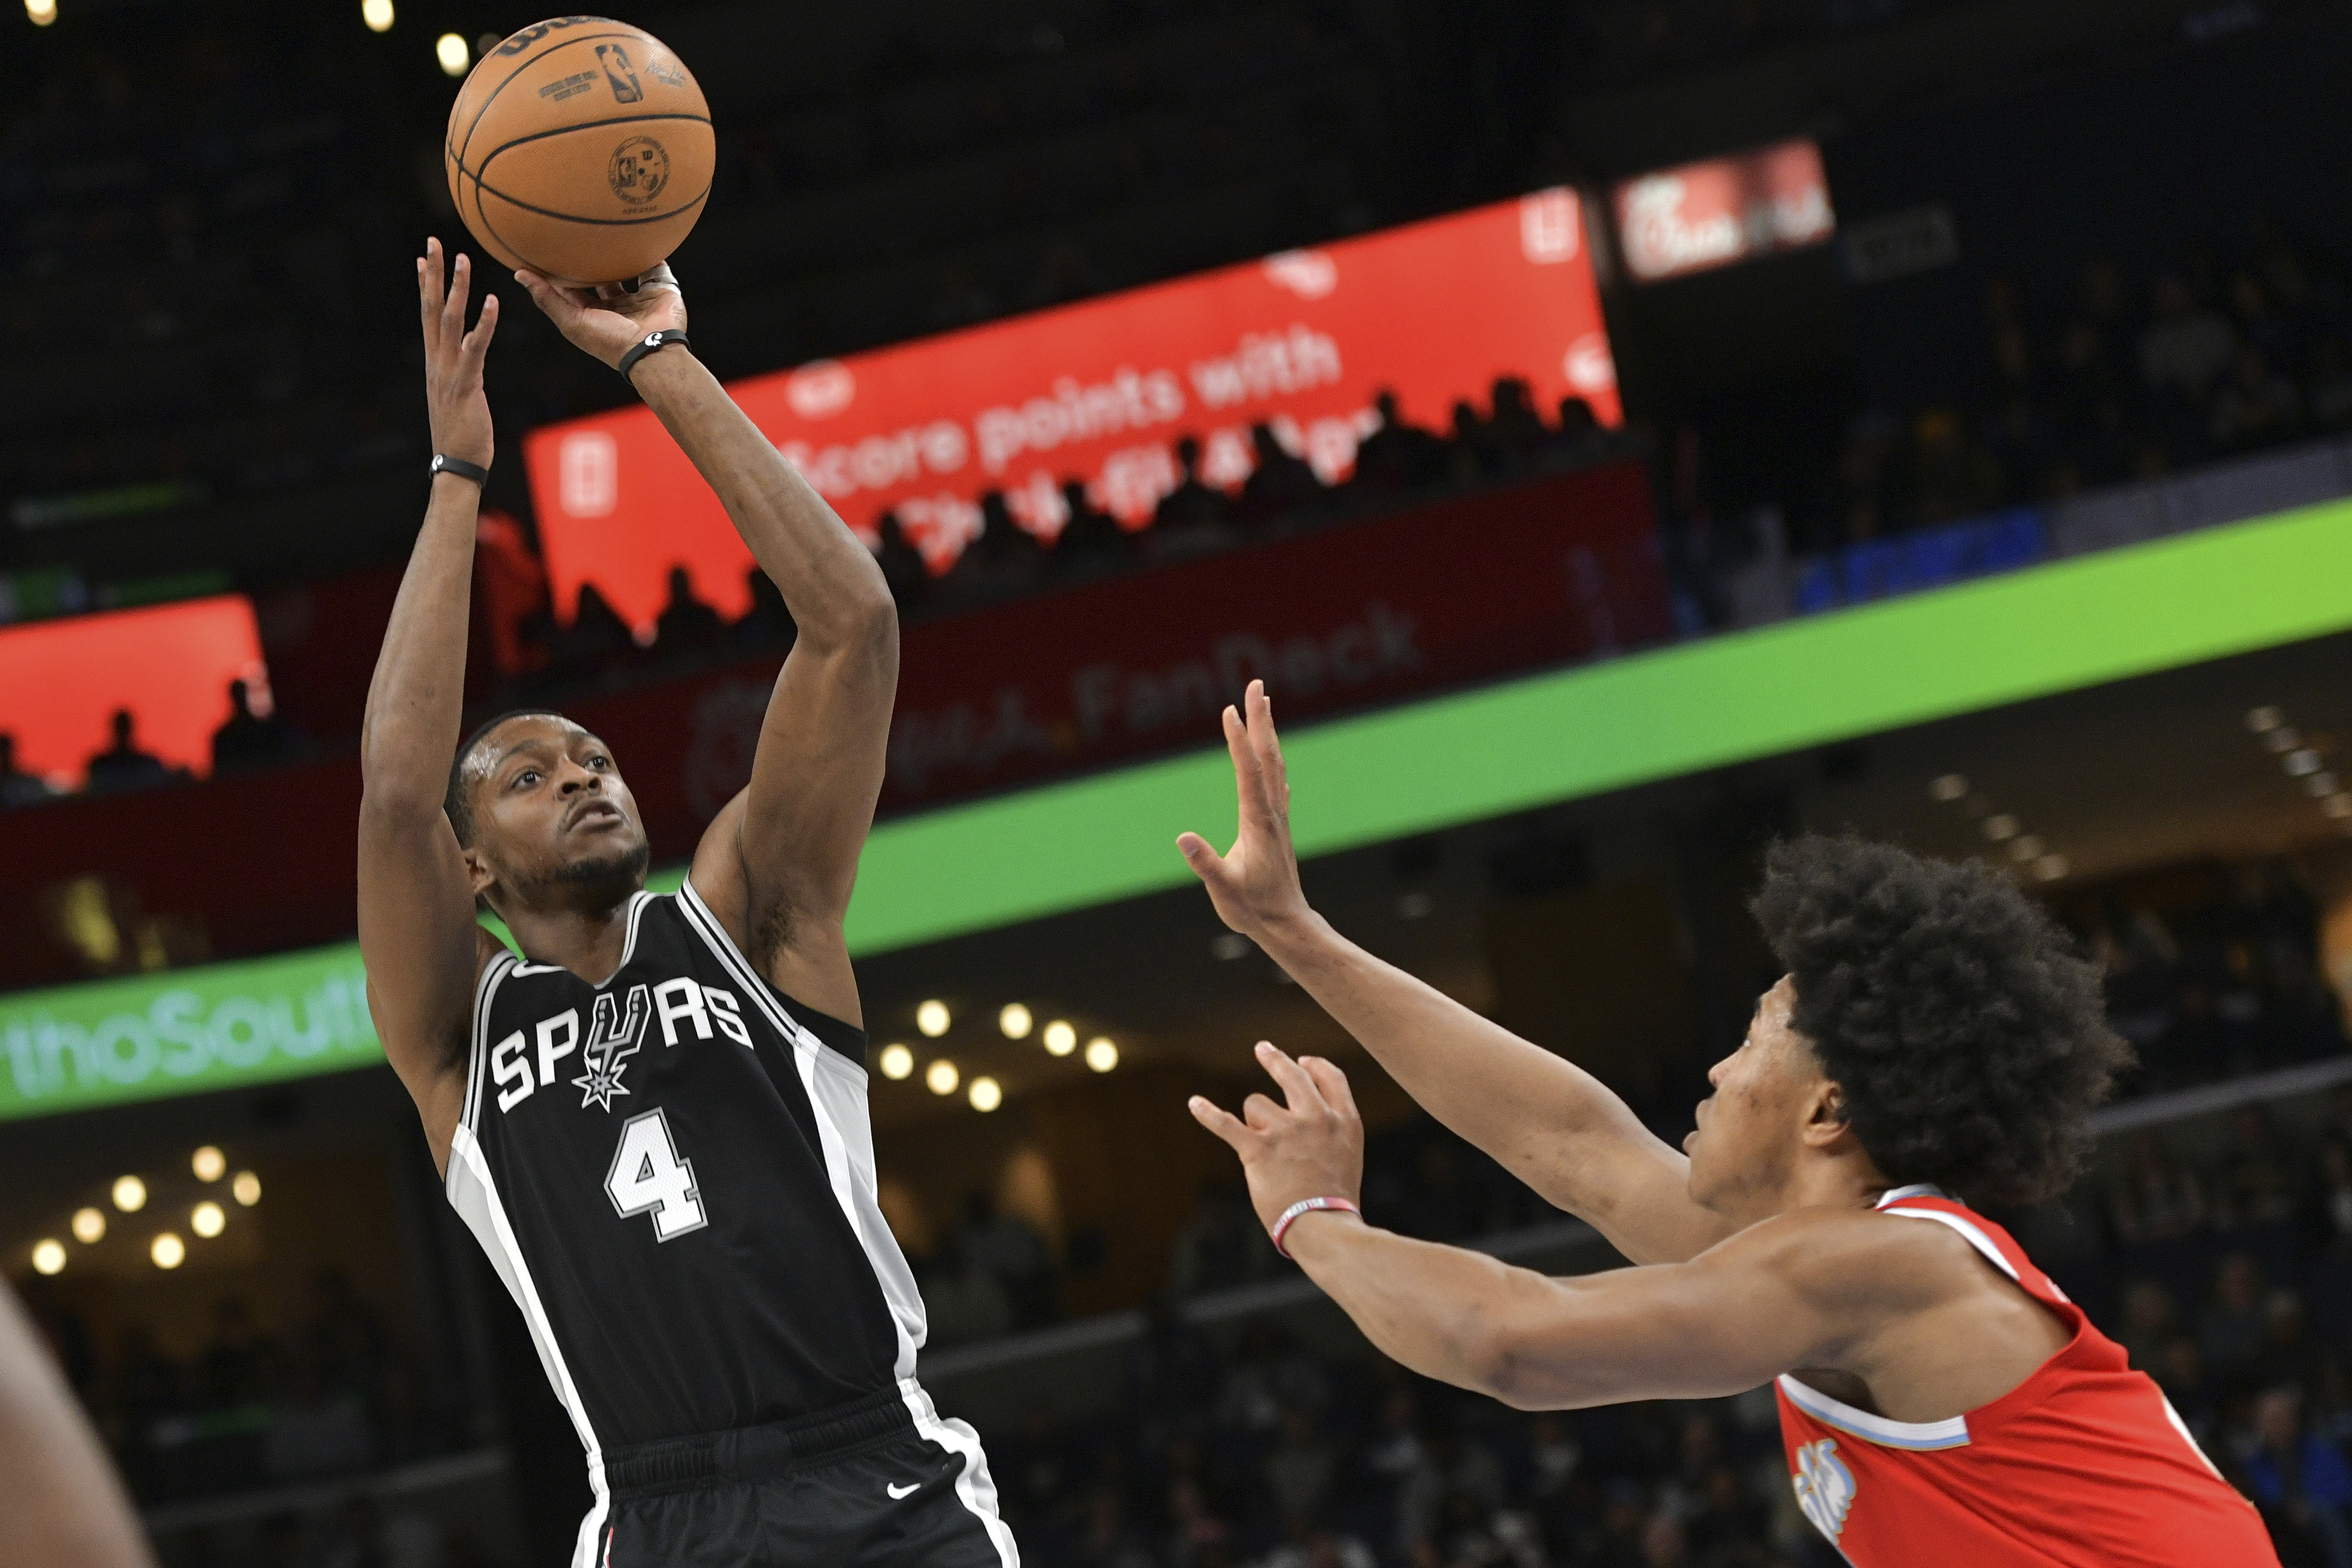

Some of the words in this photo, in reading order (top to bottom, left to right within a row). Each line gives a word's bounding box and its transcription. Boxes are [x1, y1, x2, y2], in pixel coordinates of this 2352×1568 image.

[975, 366, 1184, 477] points
[1188, 323, 1342, 408] with
[1073, 602, 1423, 736] FanDeck
[0, 969, 377, 1098] thoSout
[491, 977, 754, 1114] SPURS
[603, 1106, 708, 1244] 4
